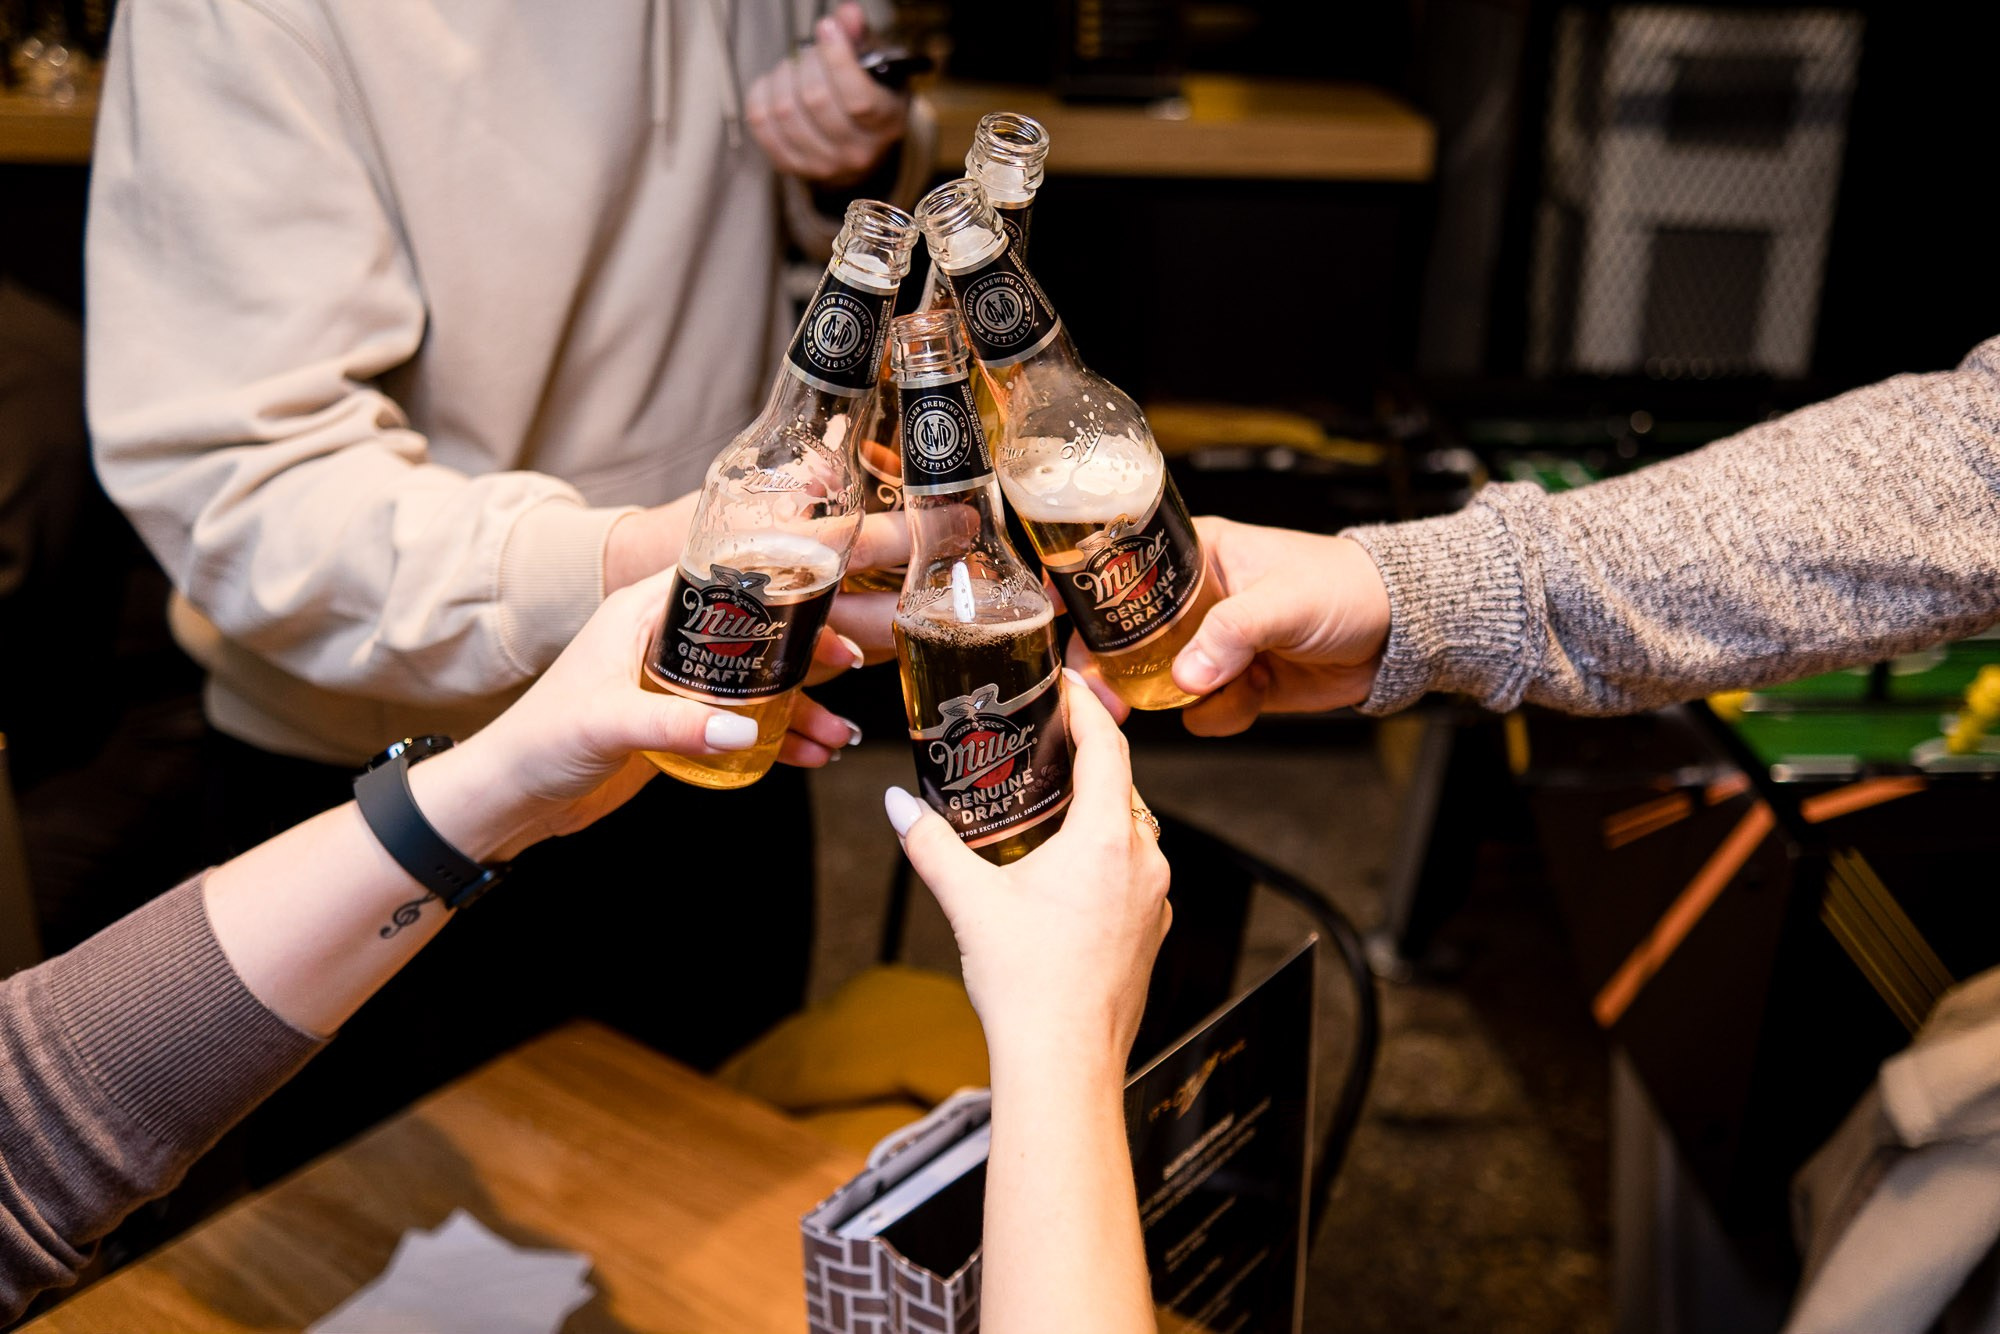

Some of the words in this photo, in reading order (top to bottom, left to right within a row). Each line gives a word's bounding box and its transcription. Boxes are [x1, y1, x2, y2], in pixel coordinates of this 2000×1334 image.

[813, 297, 836, 318] MILLER
[838, 298, 870, 326] BREWING
[967, 288, 979, 316] MILLER
[978, 276, 1014, 291] BREWING
[907, 406, 921, 434] MILLER
[922, 400, 959, 416] BREWING
[1073, 528, 1165, 603] Miller
[682, 588, 787, 638] Miller
[1106, 565, 1177, 623] GENUINE
[1120, 585, 1174, 632] DRAFT
[678, 642, 764, 669] GENUINE
[682, 659, 750, 684] DRAFT
[678, 676, 690, 685] FOR
[691, 681, 735, 694] EXCEPTIONAL
[929, 724, 1035, 782] Miller
[950, 768, 1035, 811] GENUINE
[961, 789, 1027, 825] DRAFT
[965, 829, 978, 838] FOR
[979, 812, 1023, 834] EXCEPTIONAL
[1023, 789, 1061, 816] SMOOTHNESS
